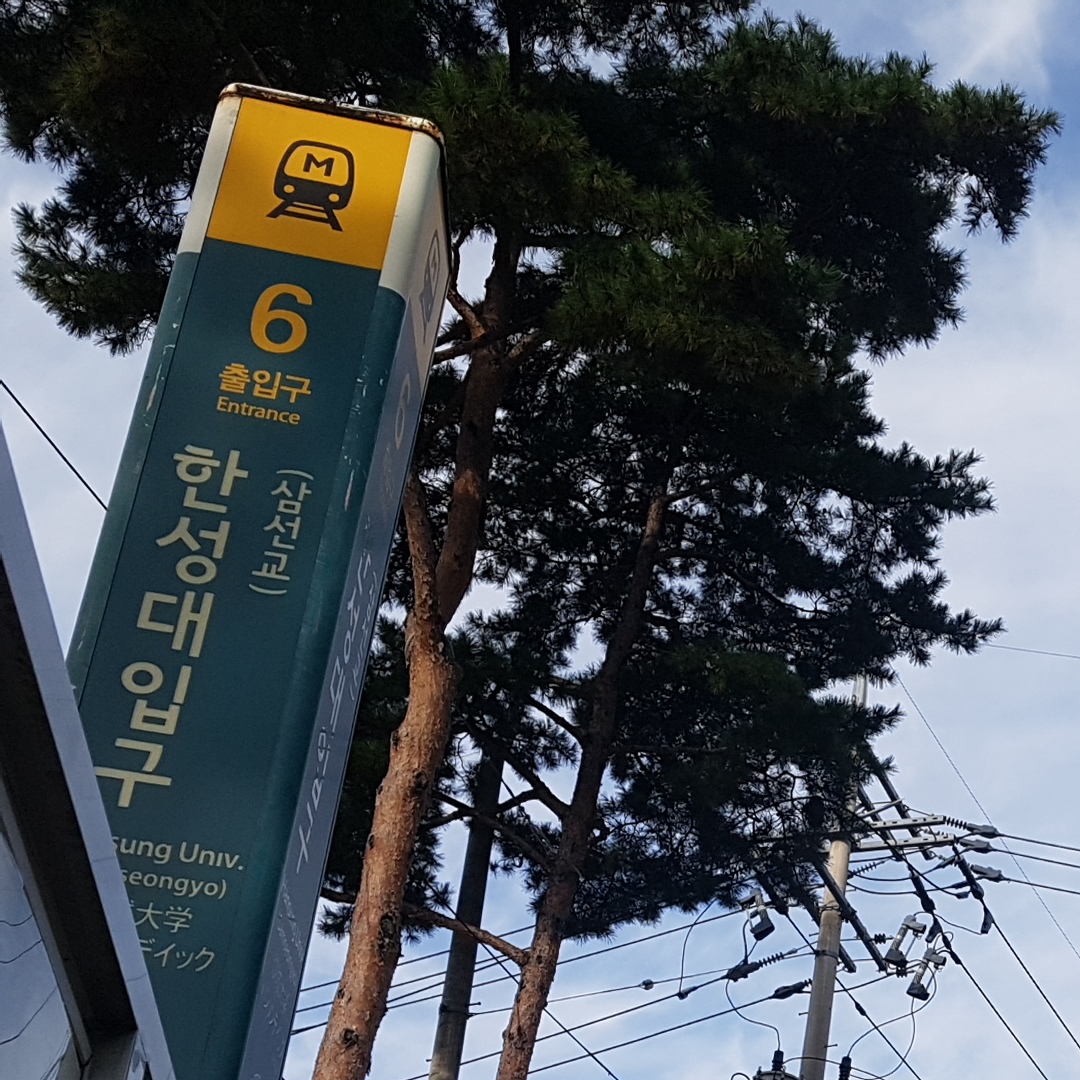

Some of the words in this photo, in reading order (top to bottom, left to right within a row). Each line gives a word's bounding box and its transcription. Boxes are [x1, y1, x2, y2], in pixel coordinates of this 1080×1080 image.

[251, 283, 313, 354] 6
[218, 362, 312, 404] 출입구
[216, 396, 301, 425] Entrance
[248, 469, 314, 596] (삼선교)
[93, 444, 249, 808] 한성대입구
[111, 836, 172, 864] sung
[179, 841, 244, 871] Univ.
[121, 869, 227, 899] seongyo)
[129, 899, 193, 933] 大学
